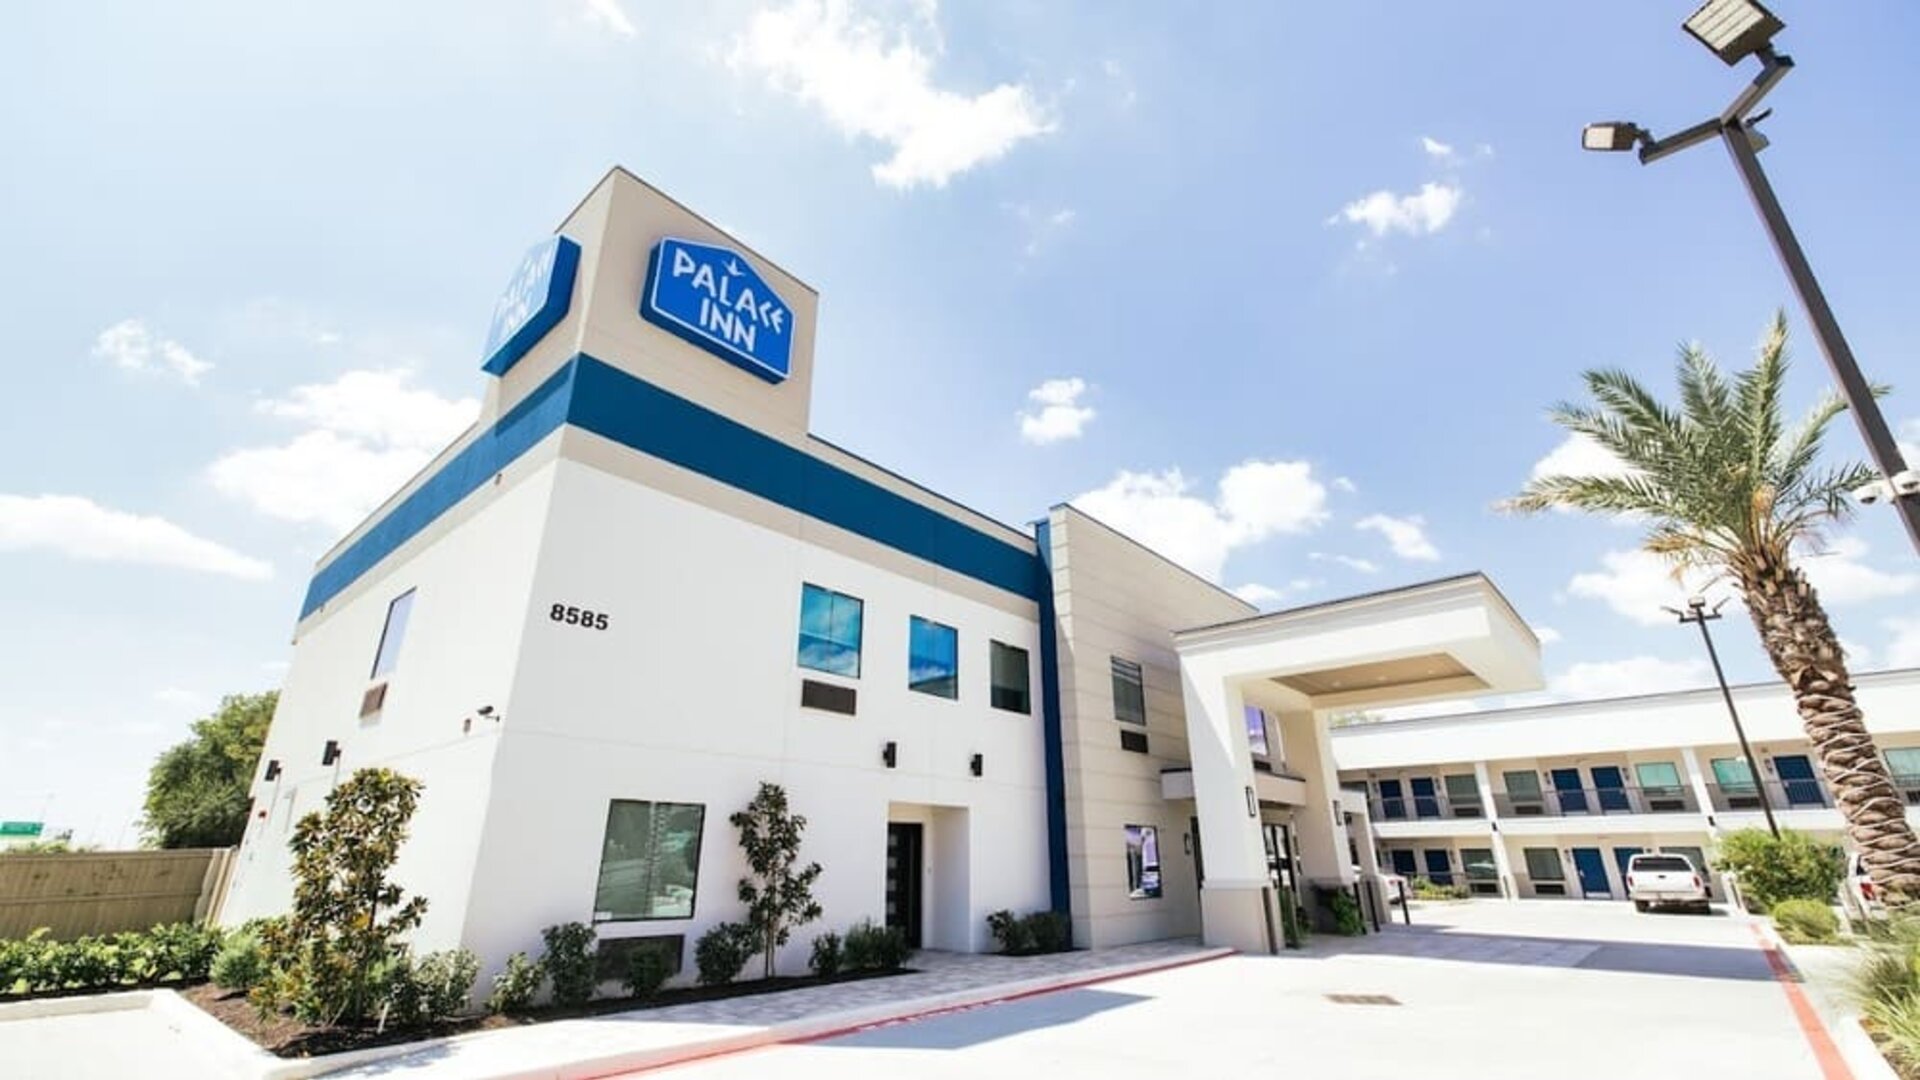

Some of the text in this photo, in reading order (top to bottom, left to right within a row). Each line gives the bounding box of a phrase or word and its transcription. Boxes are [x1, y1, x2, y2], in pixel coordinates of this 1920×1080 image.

[673, 248, 783, 334] PALACE
[700, 298, 756, 352] INN
[550, 603, 609, 630] 8585
